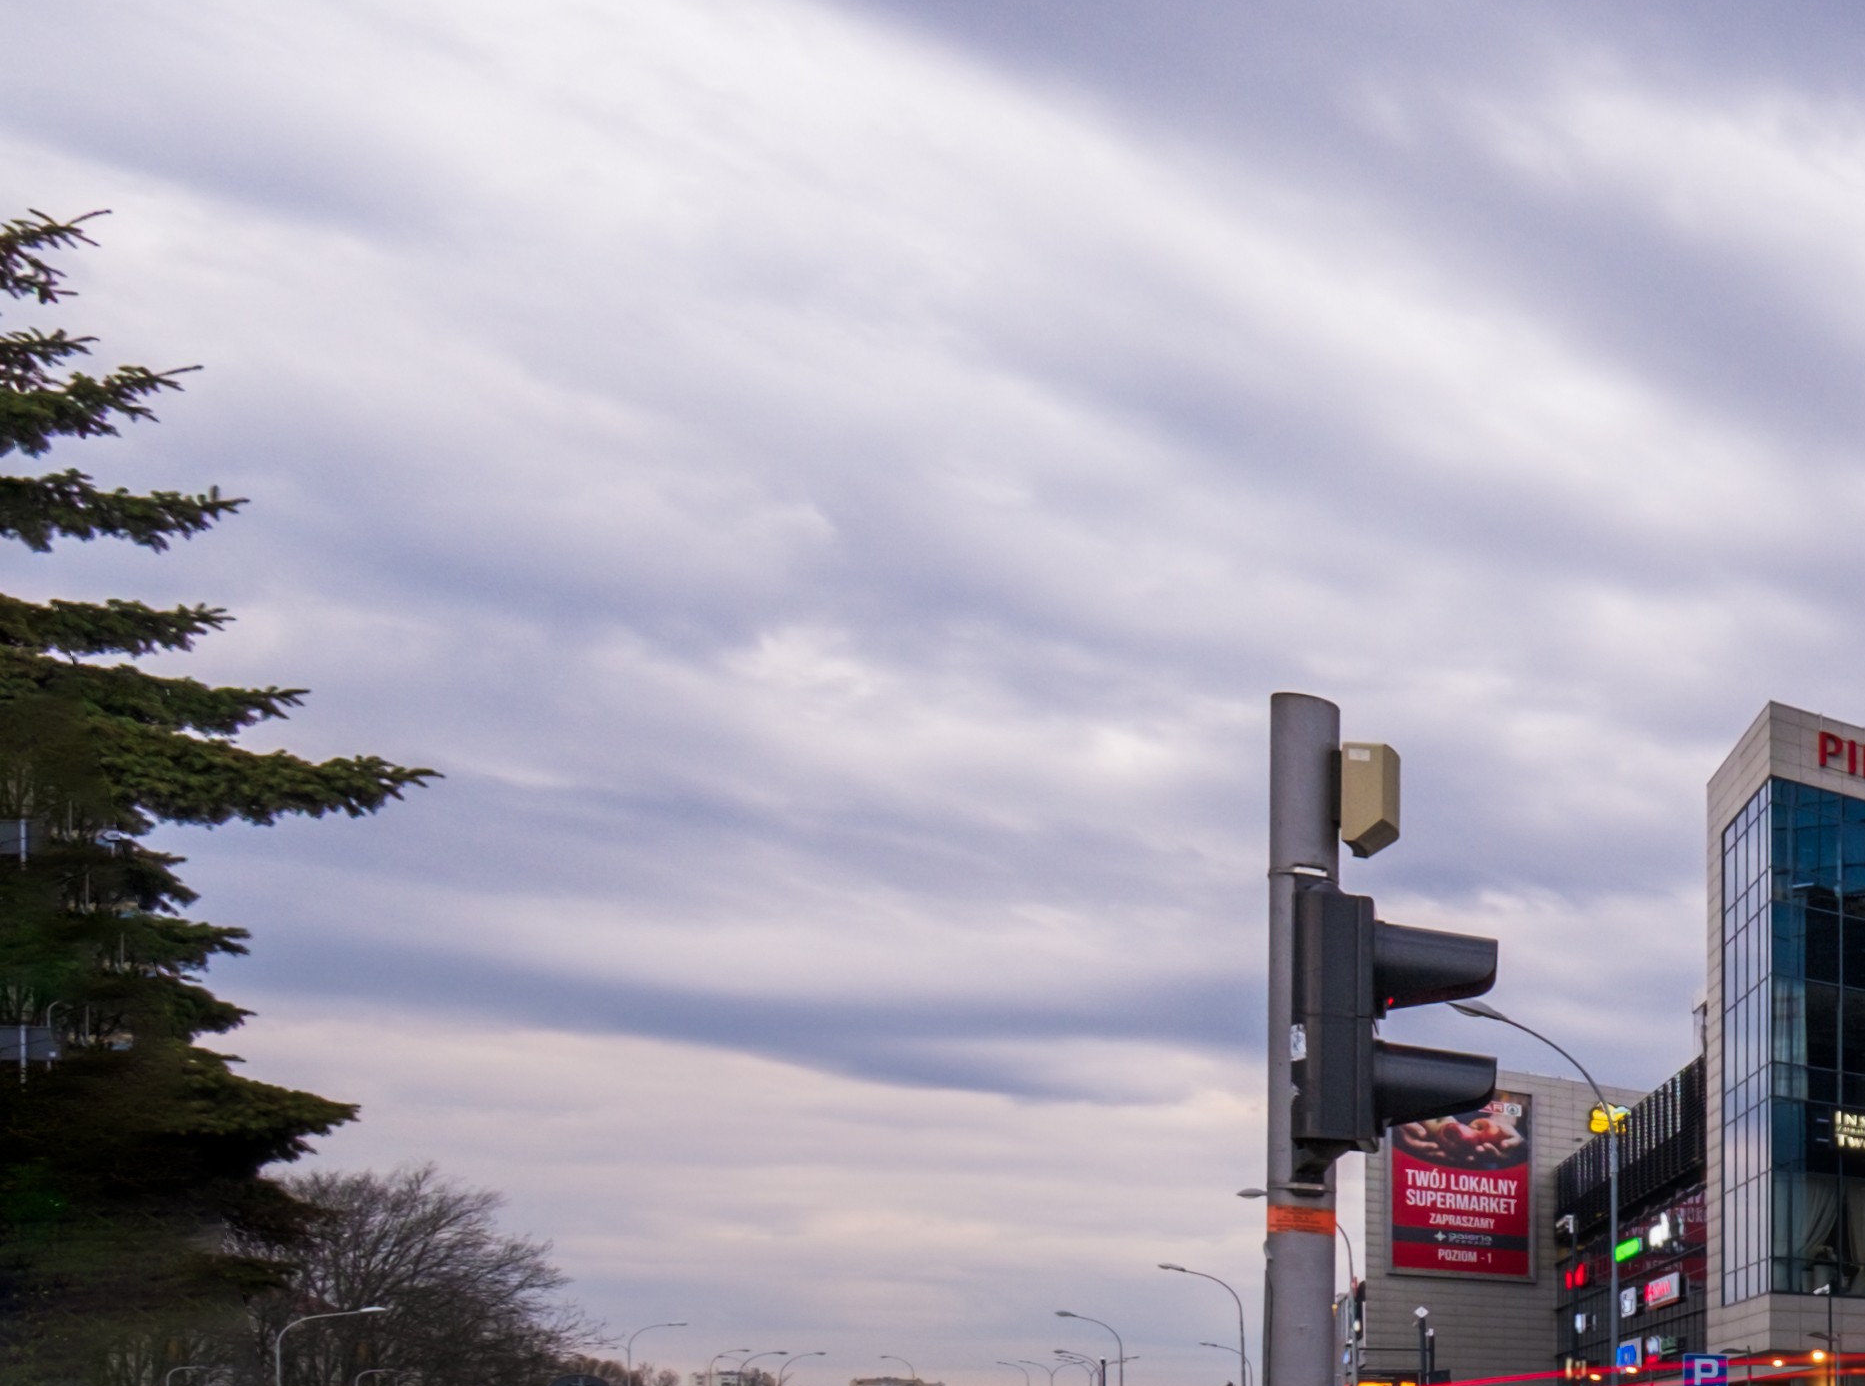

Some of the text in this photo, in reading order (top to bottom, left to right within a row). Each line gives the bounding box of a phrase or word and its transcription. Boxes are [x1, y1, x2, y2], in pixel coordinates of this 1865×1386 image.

[1405, 1168, 1518, 1196] TWÓJ LOKALNY
[1406, 1189, 1518, 1215] SUPERMARKET
[1429, 1212, 1496, 1229] ZAPRASZAMY
[1438, 1248, 1478, 1263] POZIOM
[1693, 1358, 1719, 1386] P
